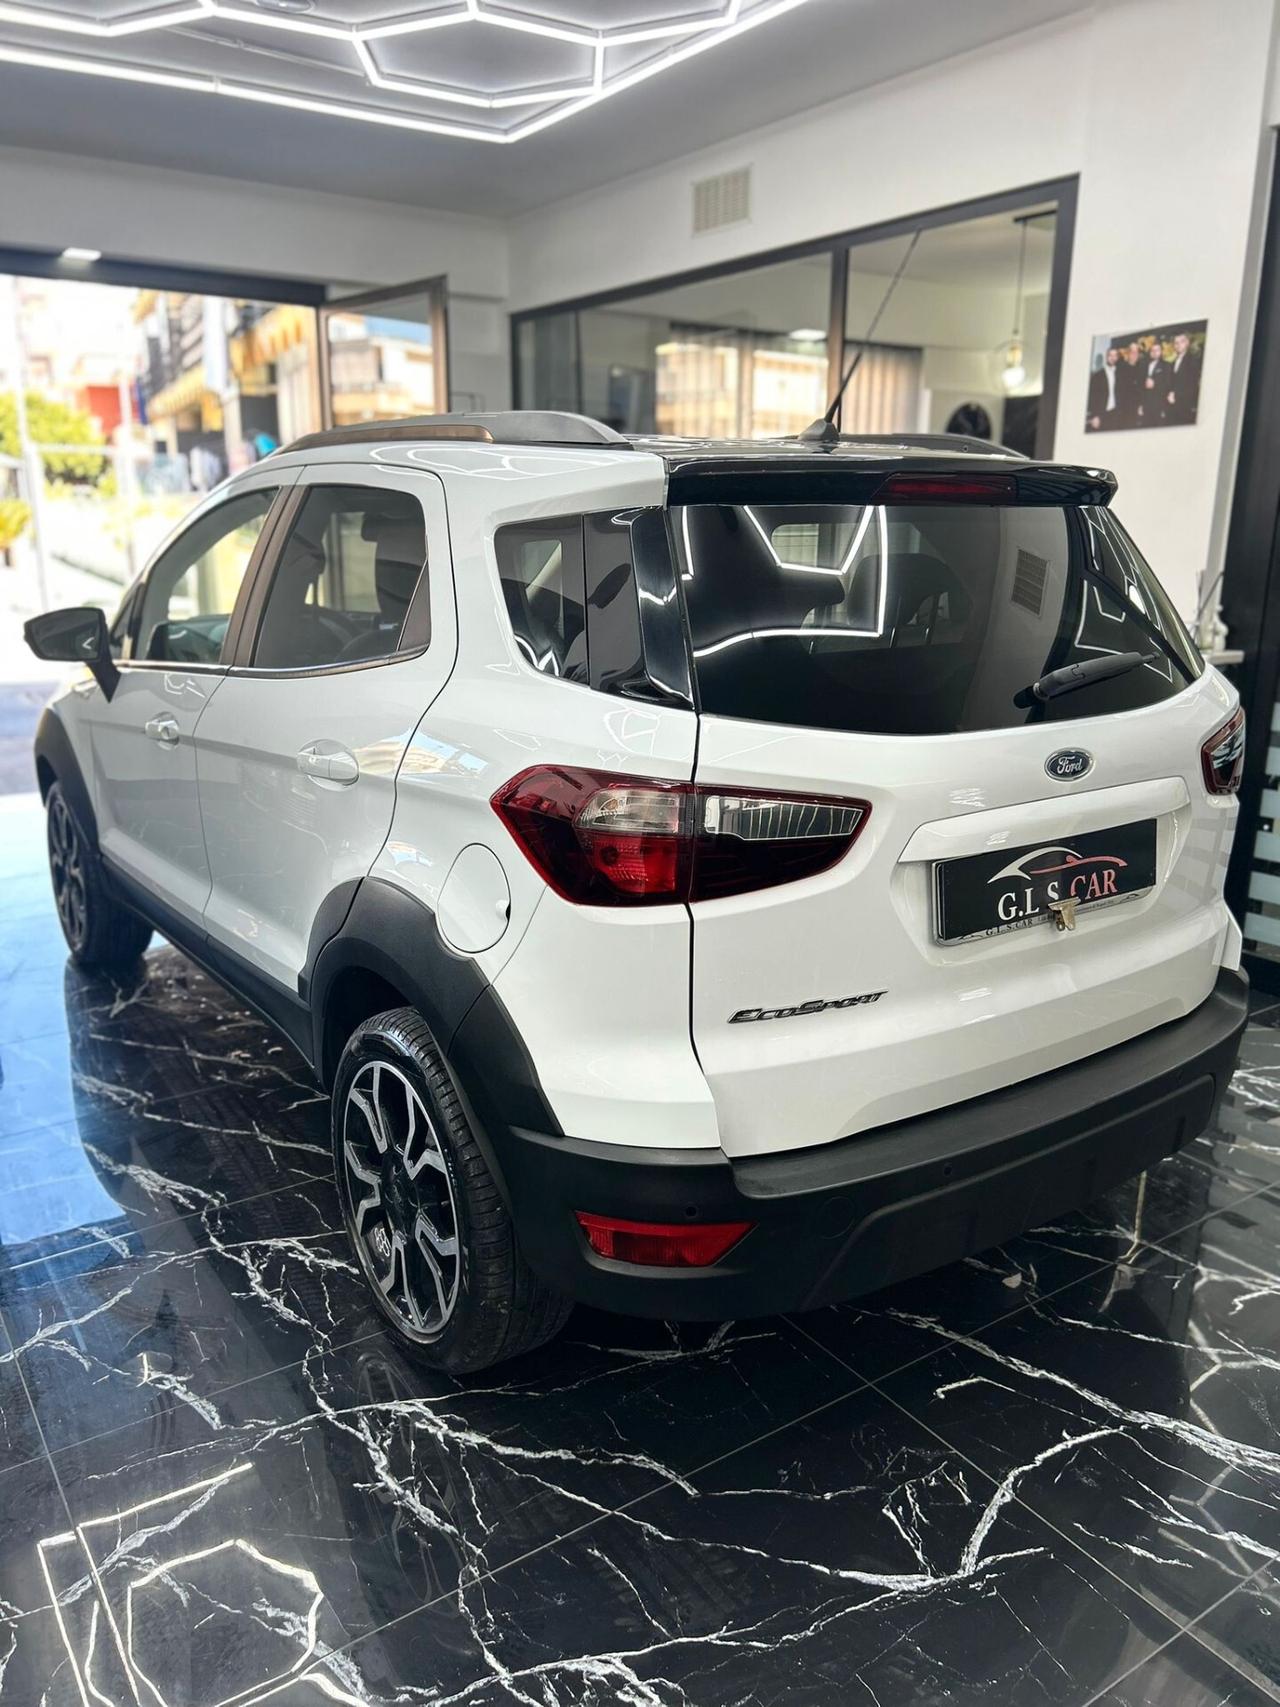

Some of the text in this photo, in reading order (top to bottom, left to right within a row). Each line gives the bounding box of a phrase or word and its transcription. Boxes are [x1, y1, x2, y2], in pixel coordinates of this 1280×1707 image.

[1057, 755, 1082, 774] Ford
[1070, 868, 1119, 900] CAR
[727, 991, 889, 1024] EcoSport
